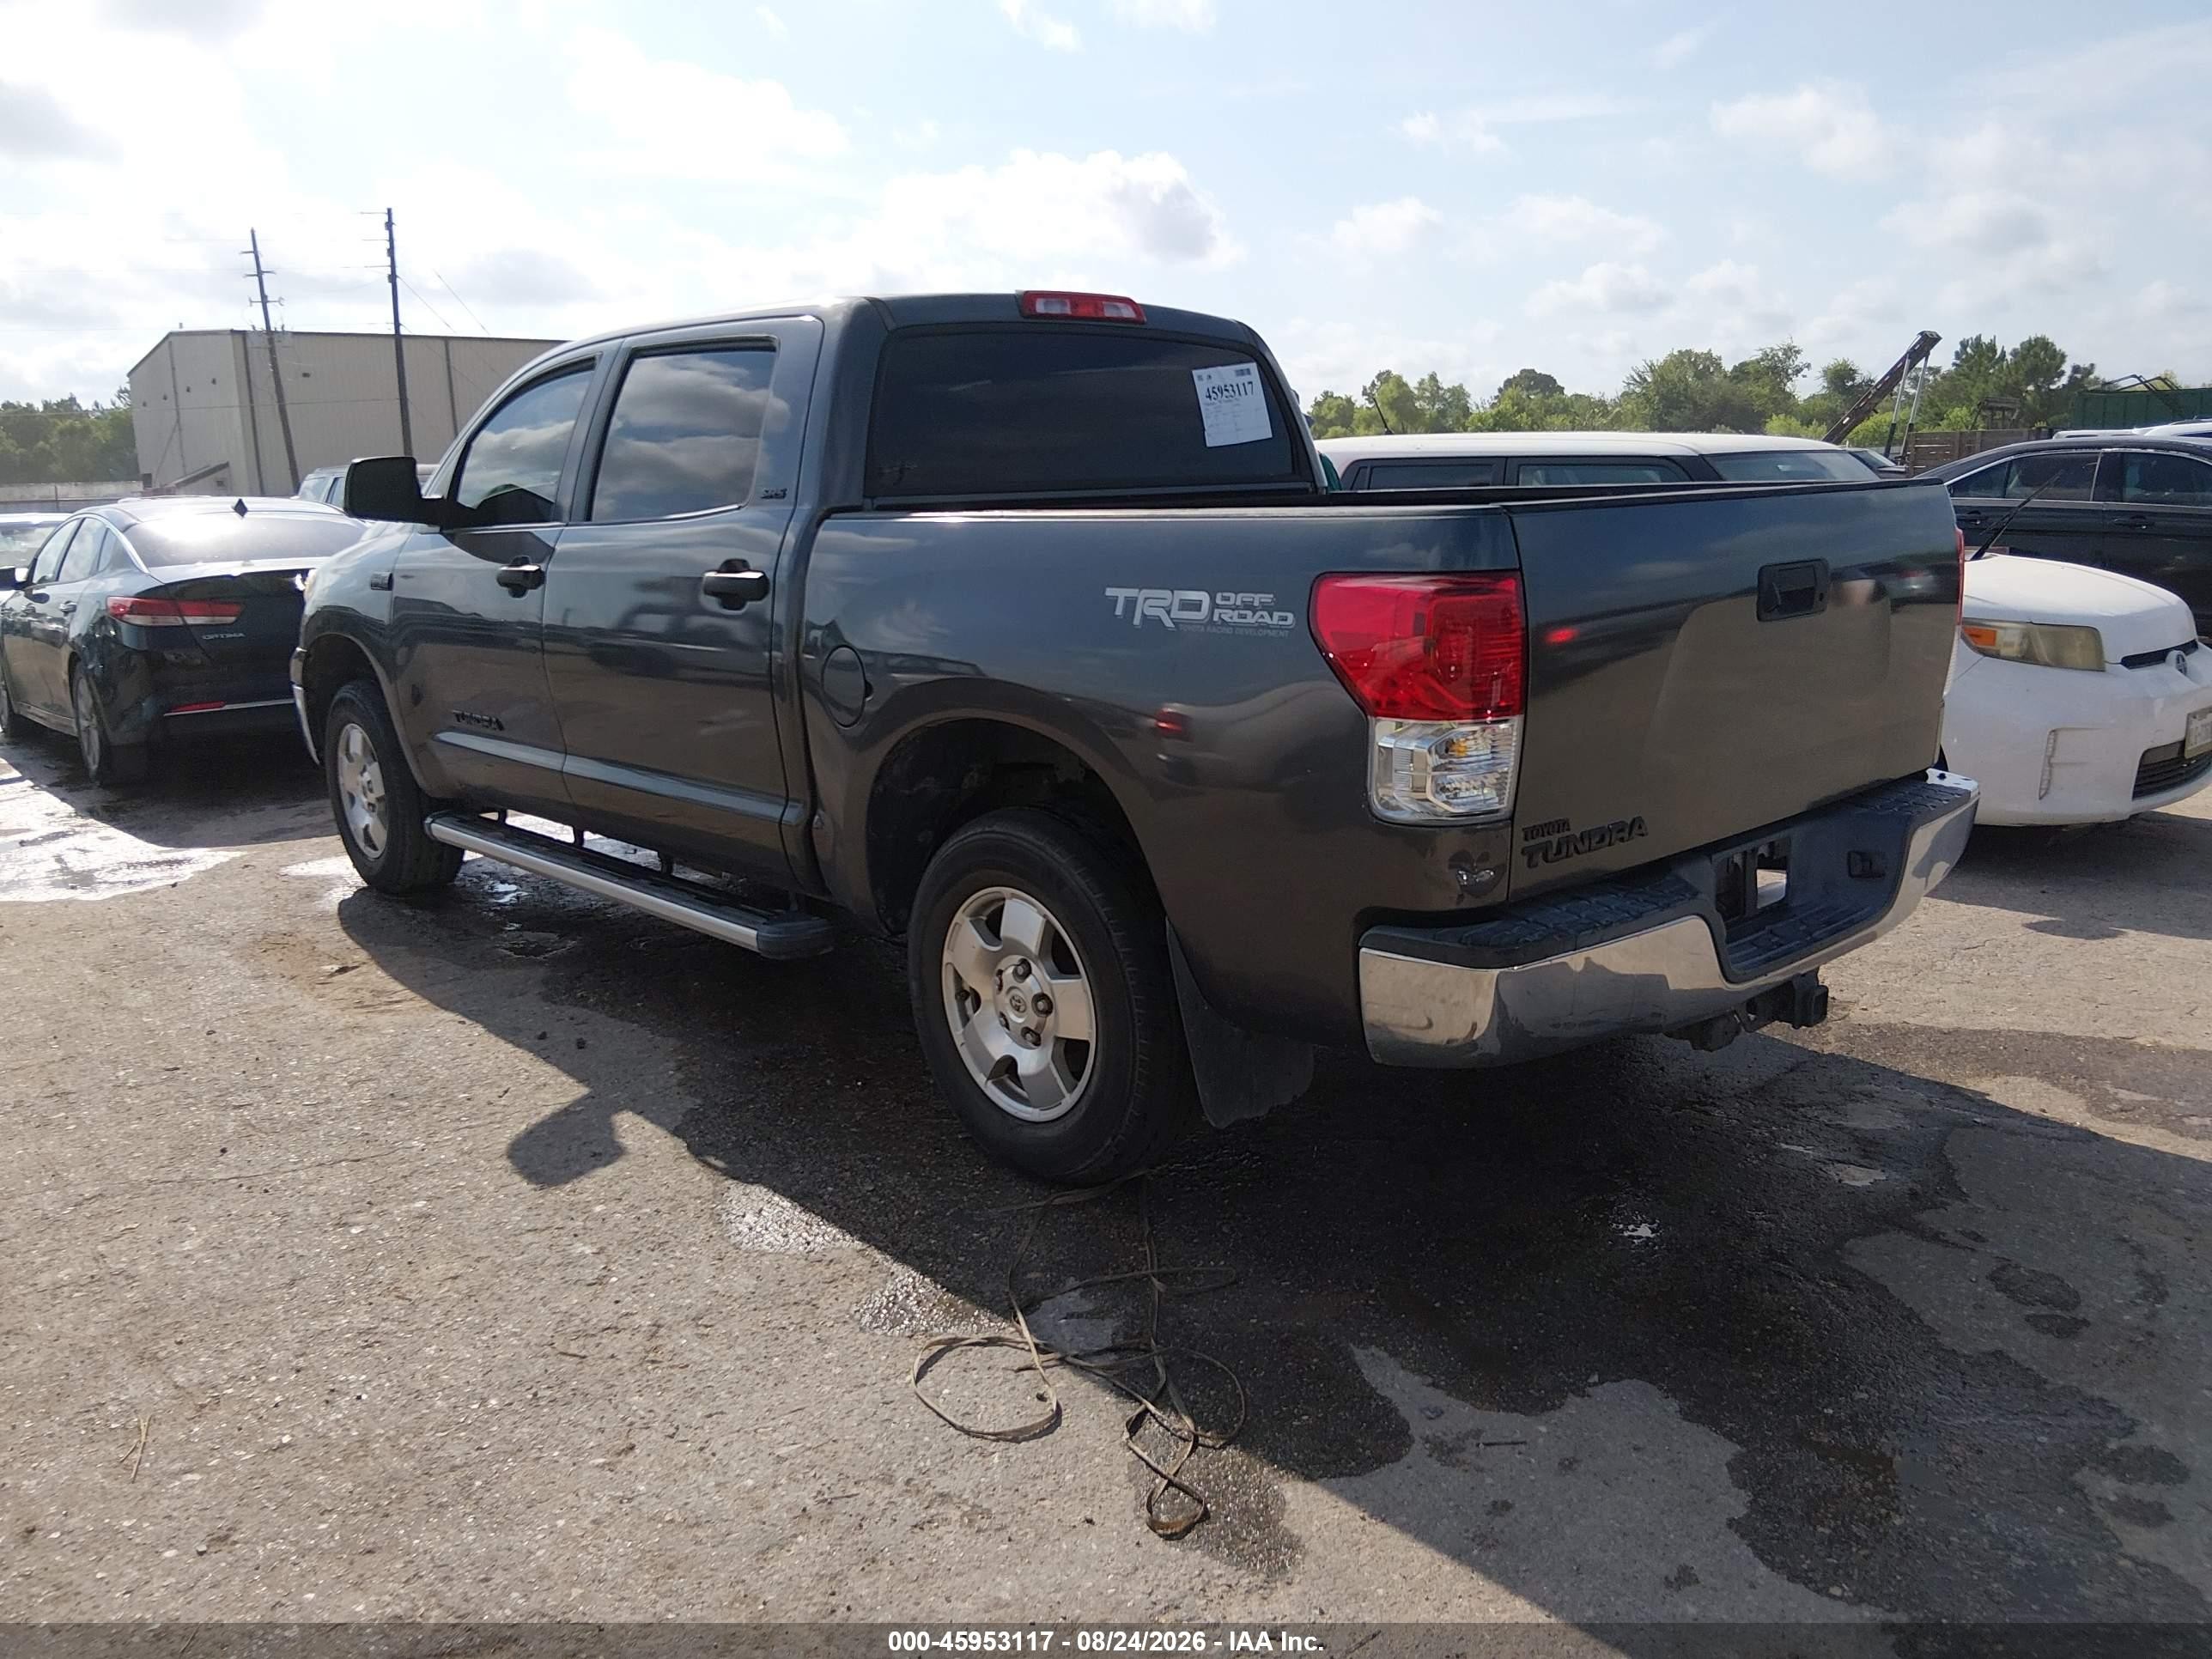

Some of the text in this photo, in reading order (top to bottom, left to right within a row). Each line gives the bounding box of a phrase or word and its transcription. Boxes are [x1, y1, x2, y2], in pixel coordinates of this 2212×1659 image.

[1205, 381, 1255, 401] 45953117
[1105, 587, 1211, 629] TRD
[1215, 592, 1274, 606] OFF
[1212, 608, 1295, 627] ROAD
[1522, 818, 1571, 842] TOYOTA
[1522, 816, 1649, 869] TUNDRA
